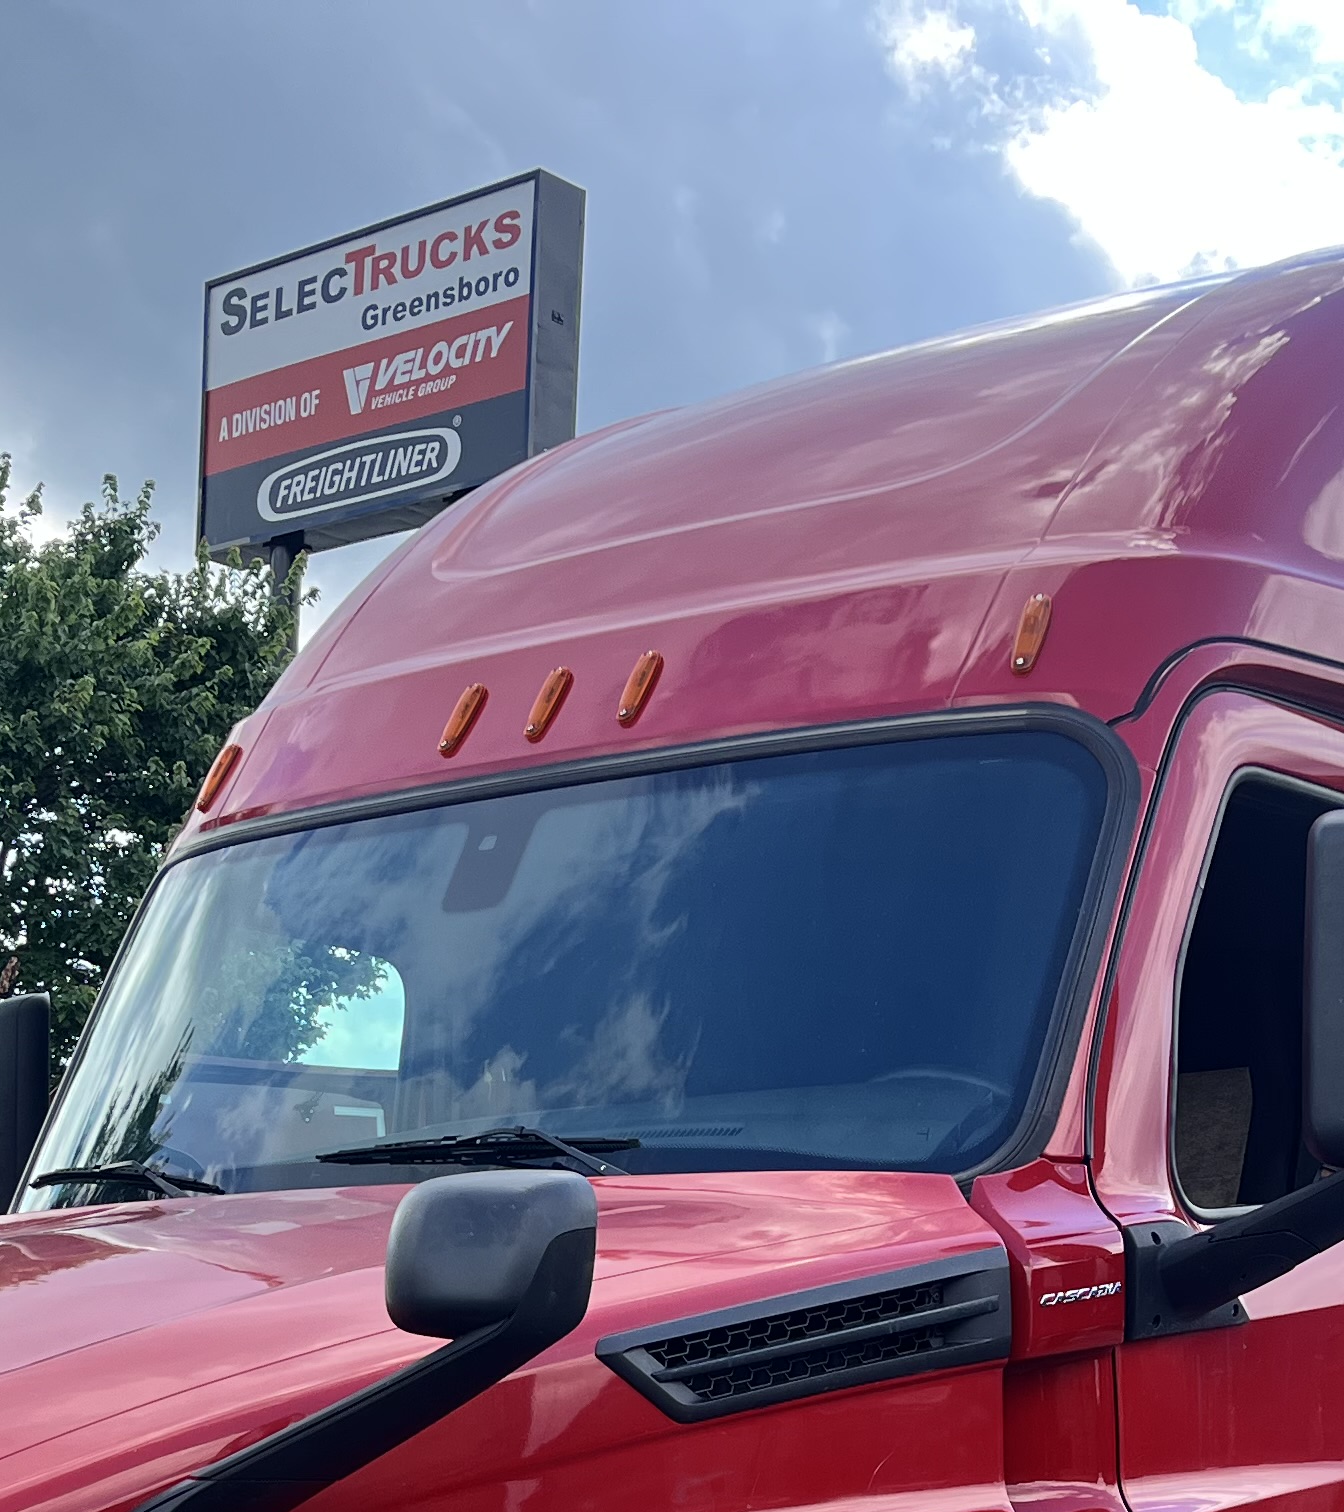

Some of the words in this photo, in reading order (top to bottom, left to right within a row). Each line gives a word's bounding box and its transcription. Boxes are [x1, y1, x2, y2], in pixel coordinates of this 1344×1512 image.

[361, 266, 520, 331] Greensboro
[374, 321, 513, 391] VELOCITY
[218, 416, 229, 442] A
[232, 396, 296, 437] DIVISION
[300, 389, 321, 418] OF
[371, 384, 415, 410] VEHICLE
[417, 375, 456, 398] GROUP
[275, 441, 440, 508] FREIGHTLINER
[1039, 1281, 1122, 1306] CASCADIA
